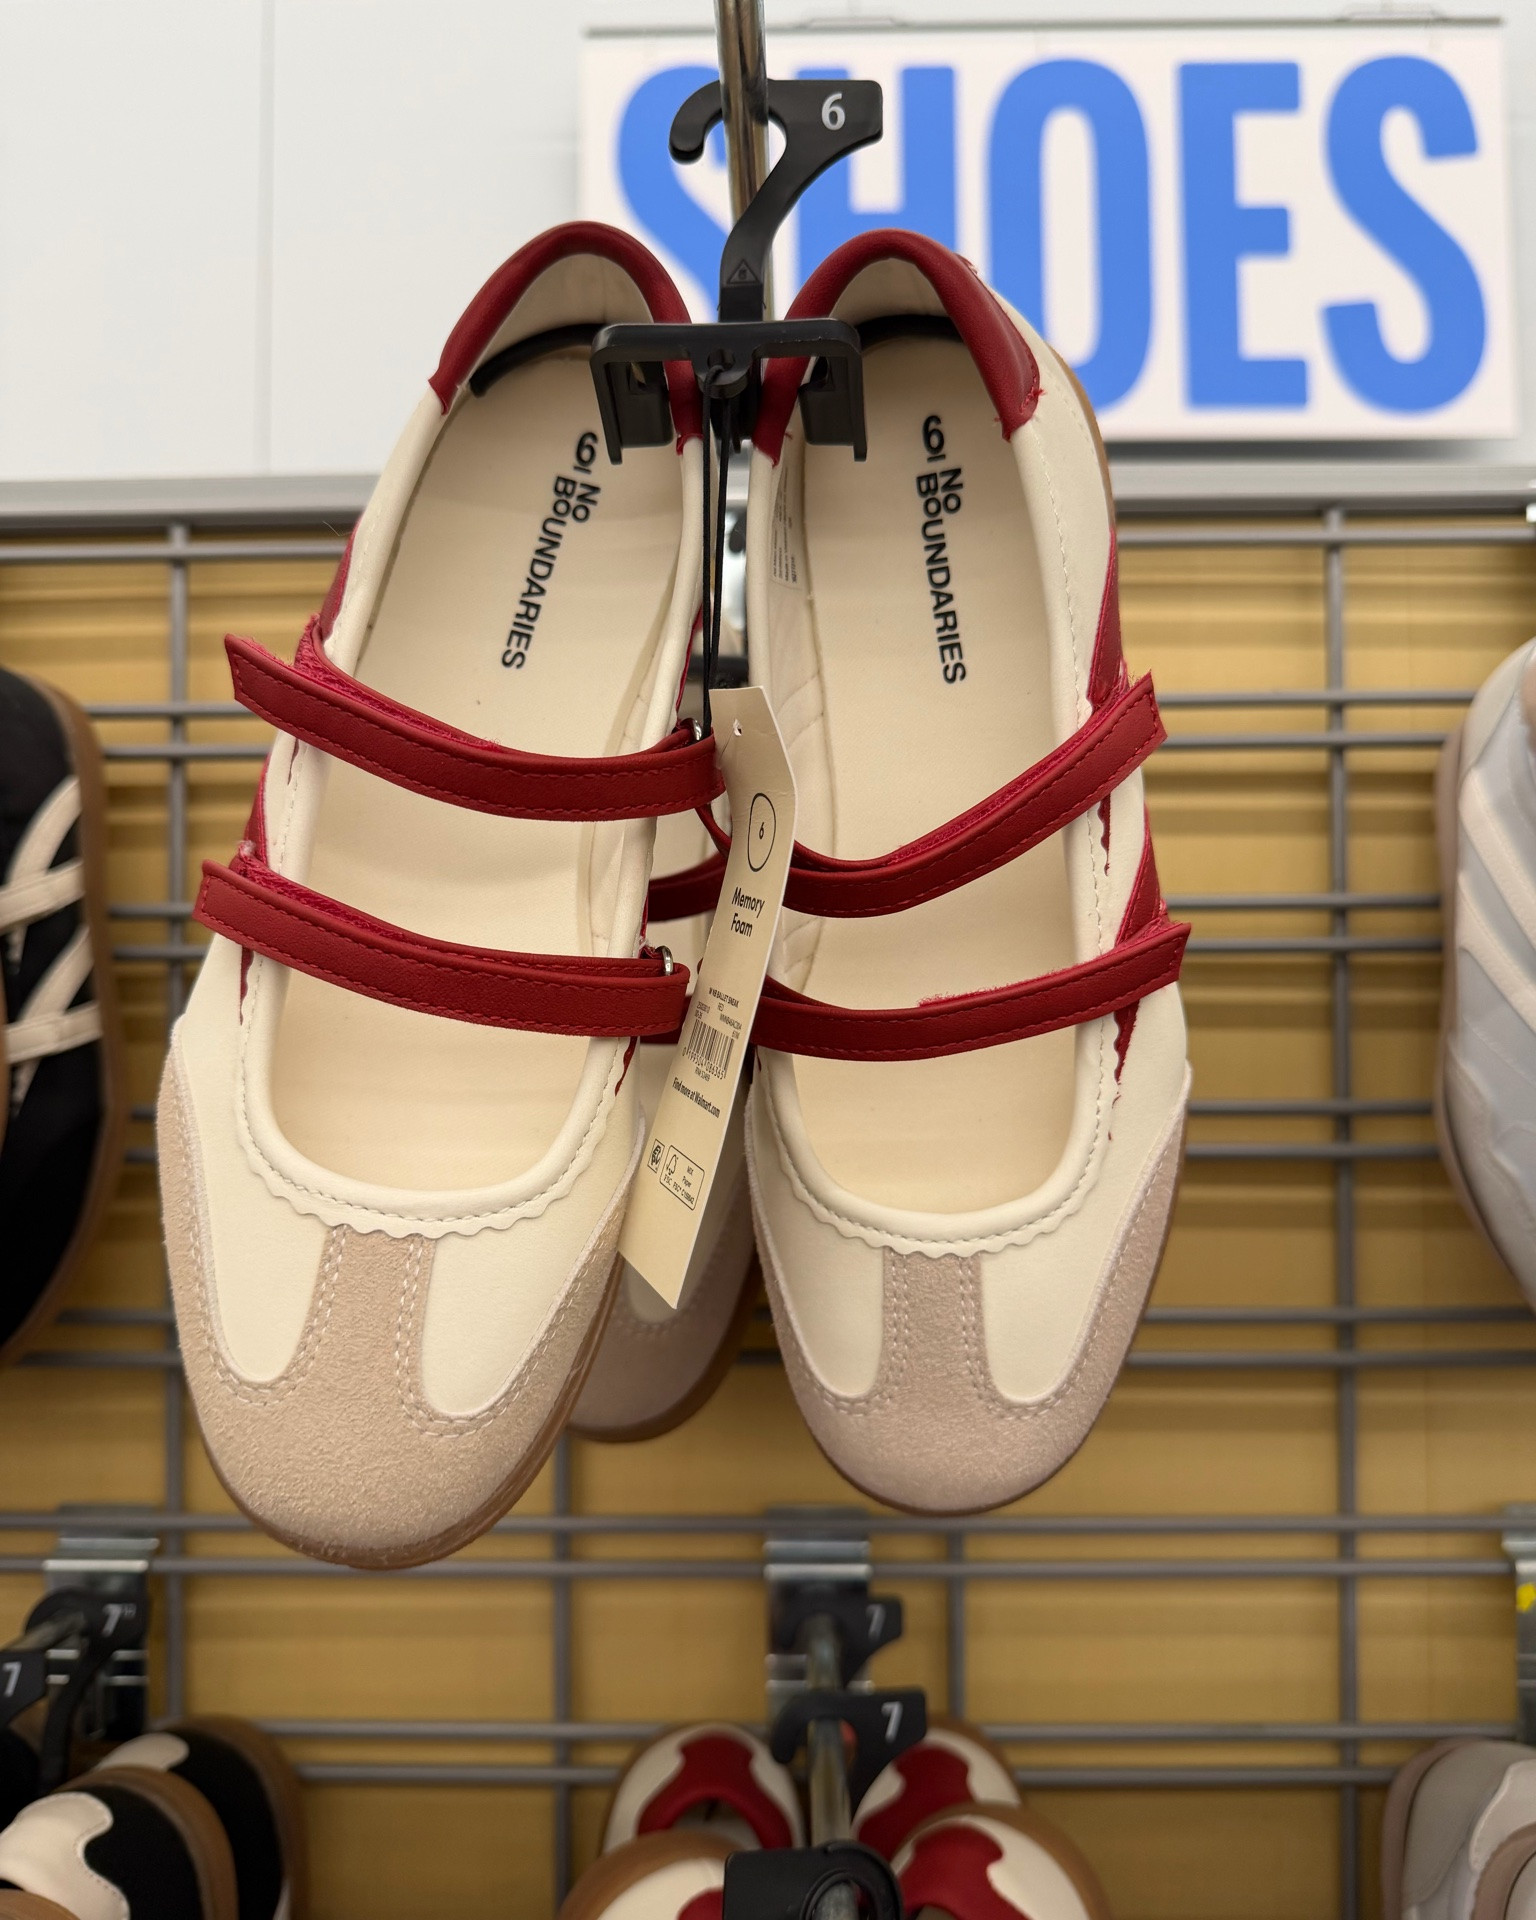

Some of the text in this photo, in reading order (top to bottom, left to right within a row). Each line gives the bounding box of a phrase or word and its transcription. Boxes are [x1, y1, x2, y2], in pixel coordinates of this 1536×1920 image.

[820, 92, 847, 131] 6
[574, 432, 598, 467] 6
[921, 415, 945, 455] 6
[571, 482, 602, 524] NO
[938, 467, 964, 515] NO
[500, 475, 578, 670] BOUNDARIES
[915, 472, 967, 685] BOUNDARIES
[758, 821, 765, 840] 6
[731, 886, 766, 919] Memory
[730, 912, 753, 938] Foam
[672, 1076, 721, 1118] Find more at Walmart.com
[866, 1603, 887, 1641] 7
[2, 1661, 22, 1698] 7
[880, 1701, 904, 1745] 7
